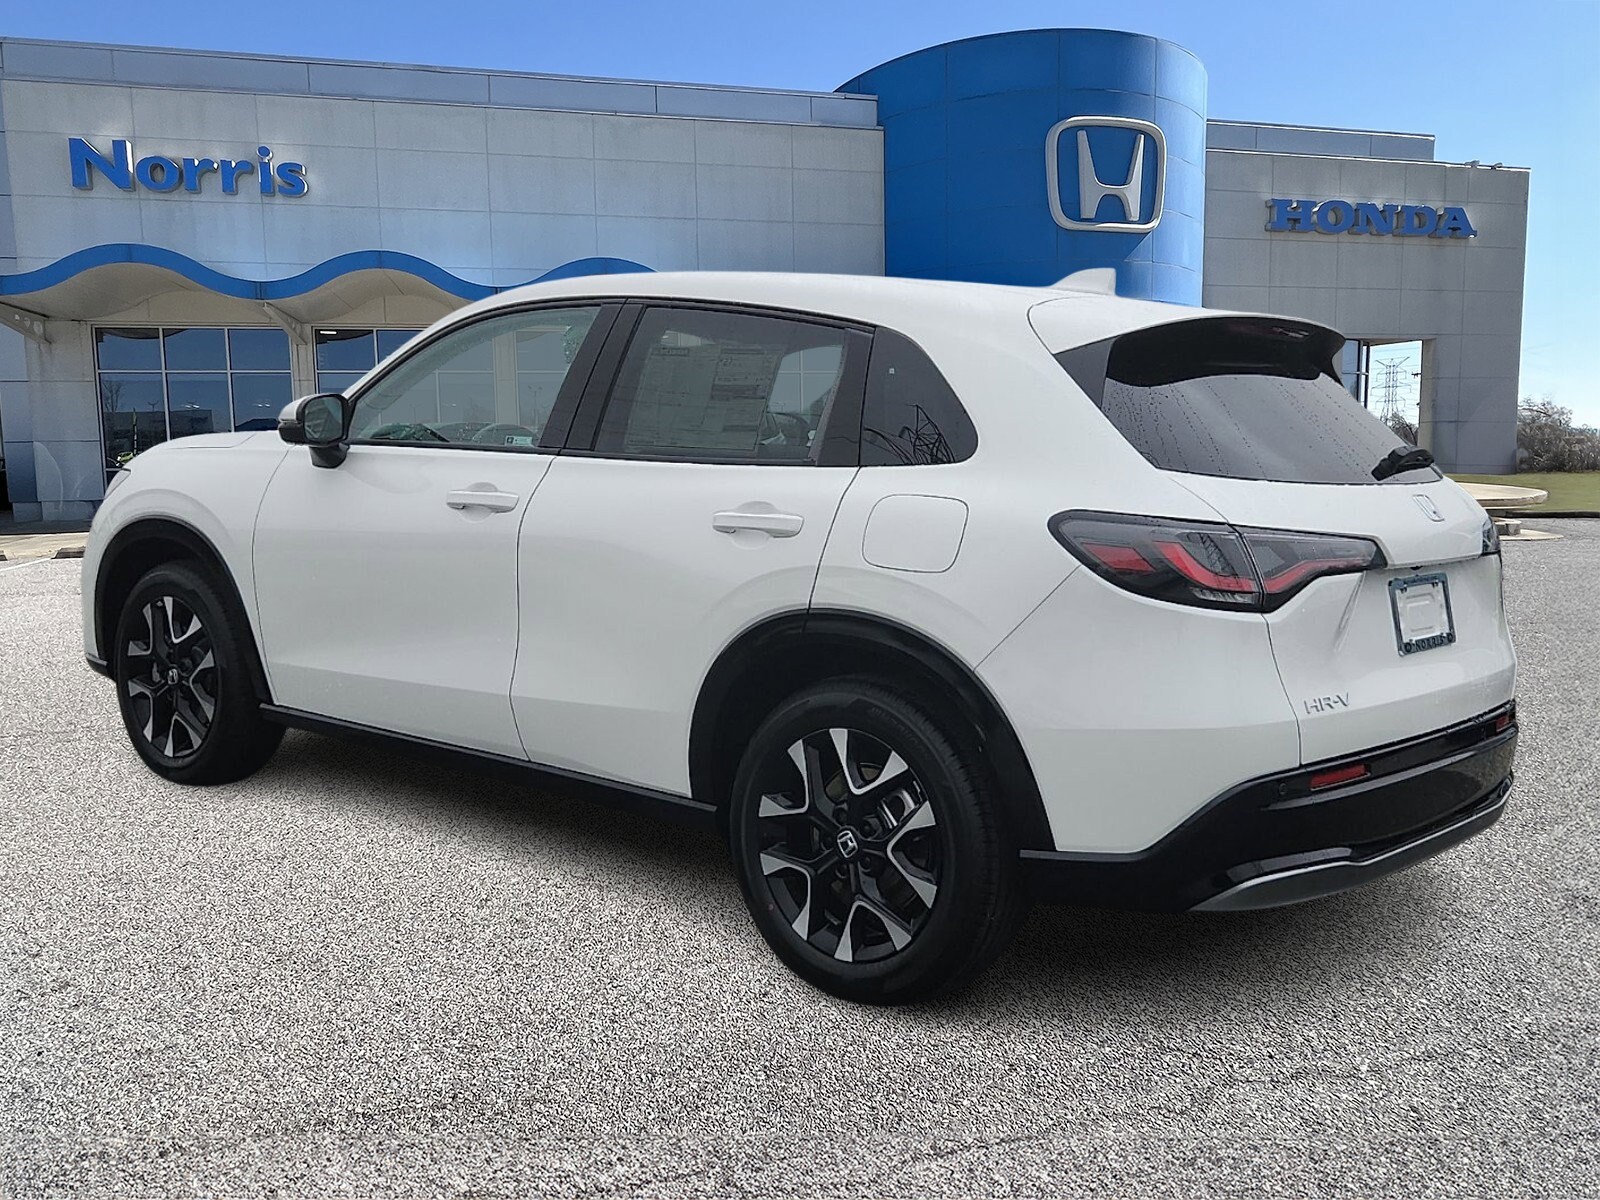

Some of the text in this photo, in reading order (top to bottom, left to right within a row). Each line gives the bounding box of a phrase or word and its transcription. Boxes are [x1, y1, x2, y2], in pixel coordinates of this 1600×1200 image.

[69, 137, 308, 197] Norris
[1266, 198, 1477, 238] HONDA
[1415, 635, 1445, 651] NORRIS
[1304, 693, 1349, 714] HR-V
